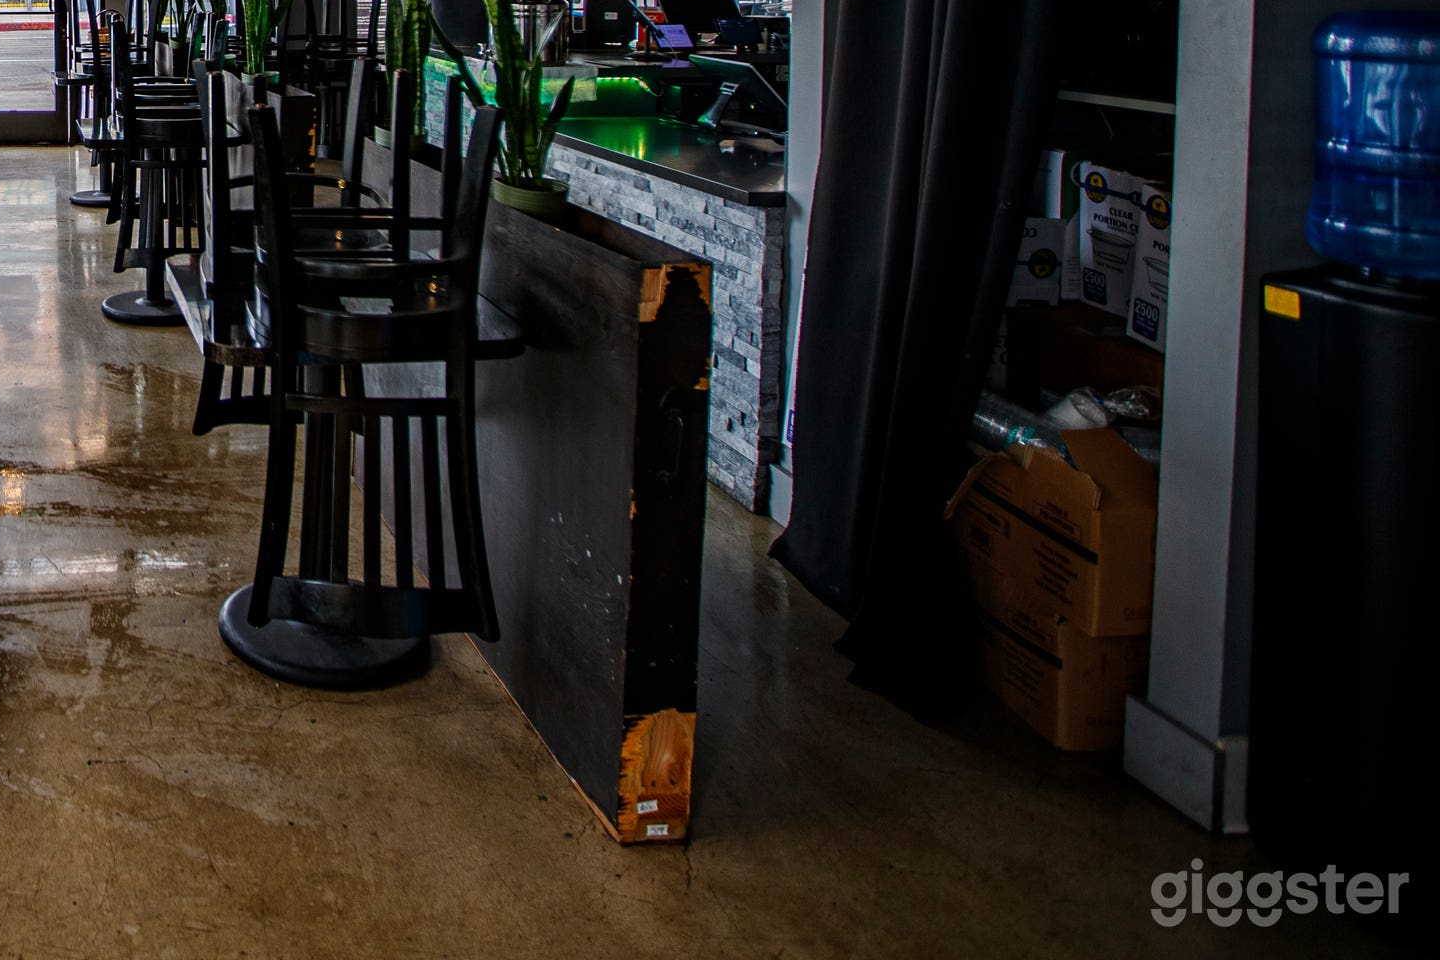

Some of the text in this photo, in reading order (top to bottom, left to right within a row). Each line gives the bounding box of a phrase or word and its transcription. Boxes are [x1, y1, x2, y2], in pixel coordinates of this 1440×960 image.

[1093, 213, 1128, 230] PORTION
[1109, 207, 1134, 220] CLEAR
[1084, 268, 1105, 286] 2500
[1134, 300, 1159, 323] 2500
